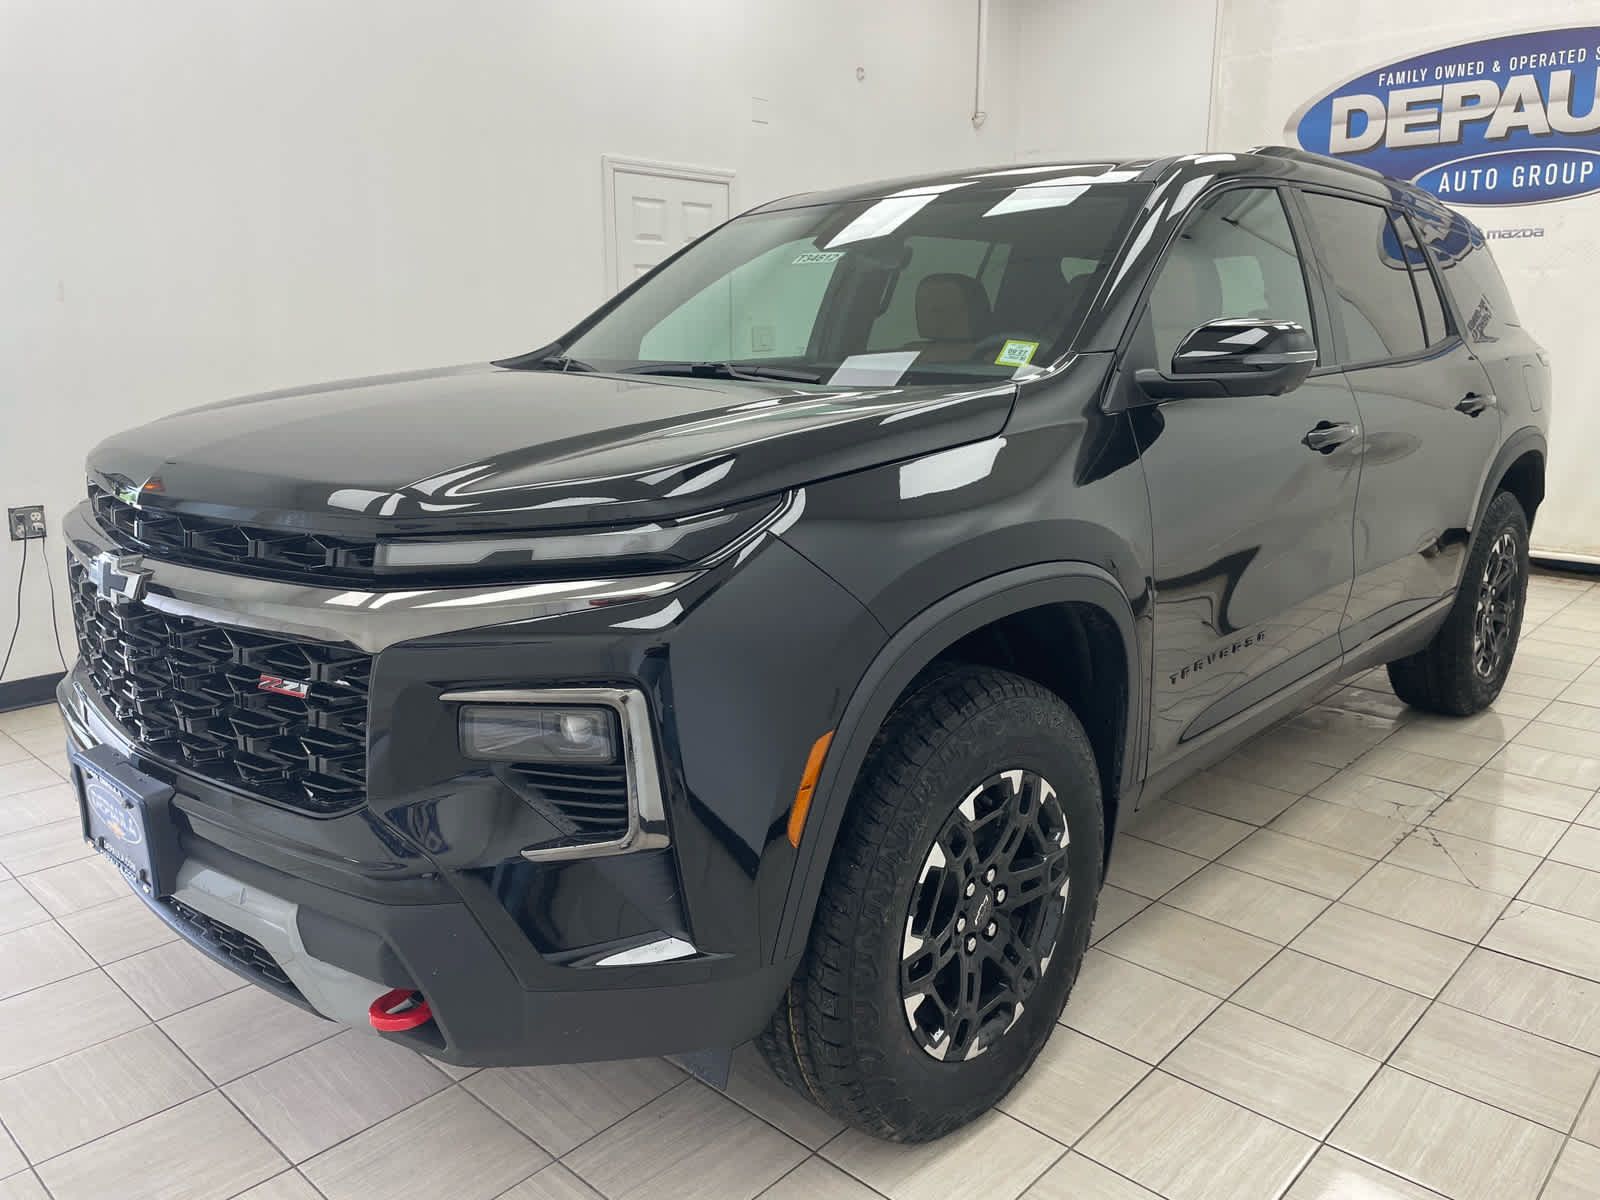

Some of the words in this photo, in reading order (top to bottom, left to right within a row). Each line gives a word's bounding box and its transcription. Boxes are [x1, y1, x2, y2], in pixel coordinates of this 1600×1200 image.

[1378, 67, 1428, 87] FAMILY
[1434, 61, 1485, 80] OWNED
[1492, 60, 1501, 73] &
[1509, 47, 1587, 71] OPERATED
[1438, 167, 1498, 193] AUTO
[1512, 160, 1594, 188] GROUP
[1486, 227, 1545, 240] mazda
[1168, 630, 1265, 685] TRAVERSE
